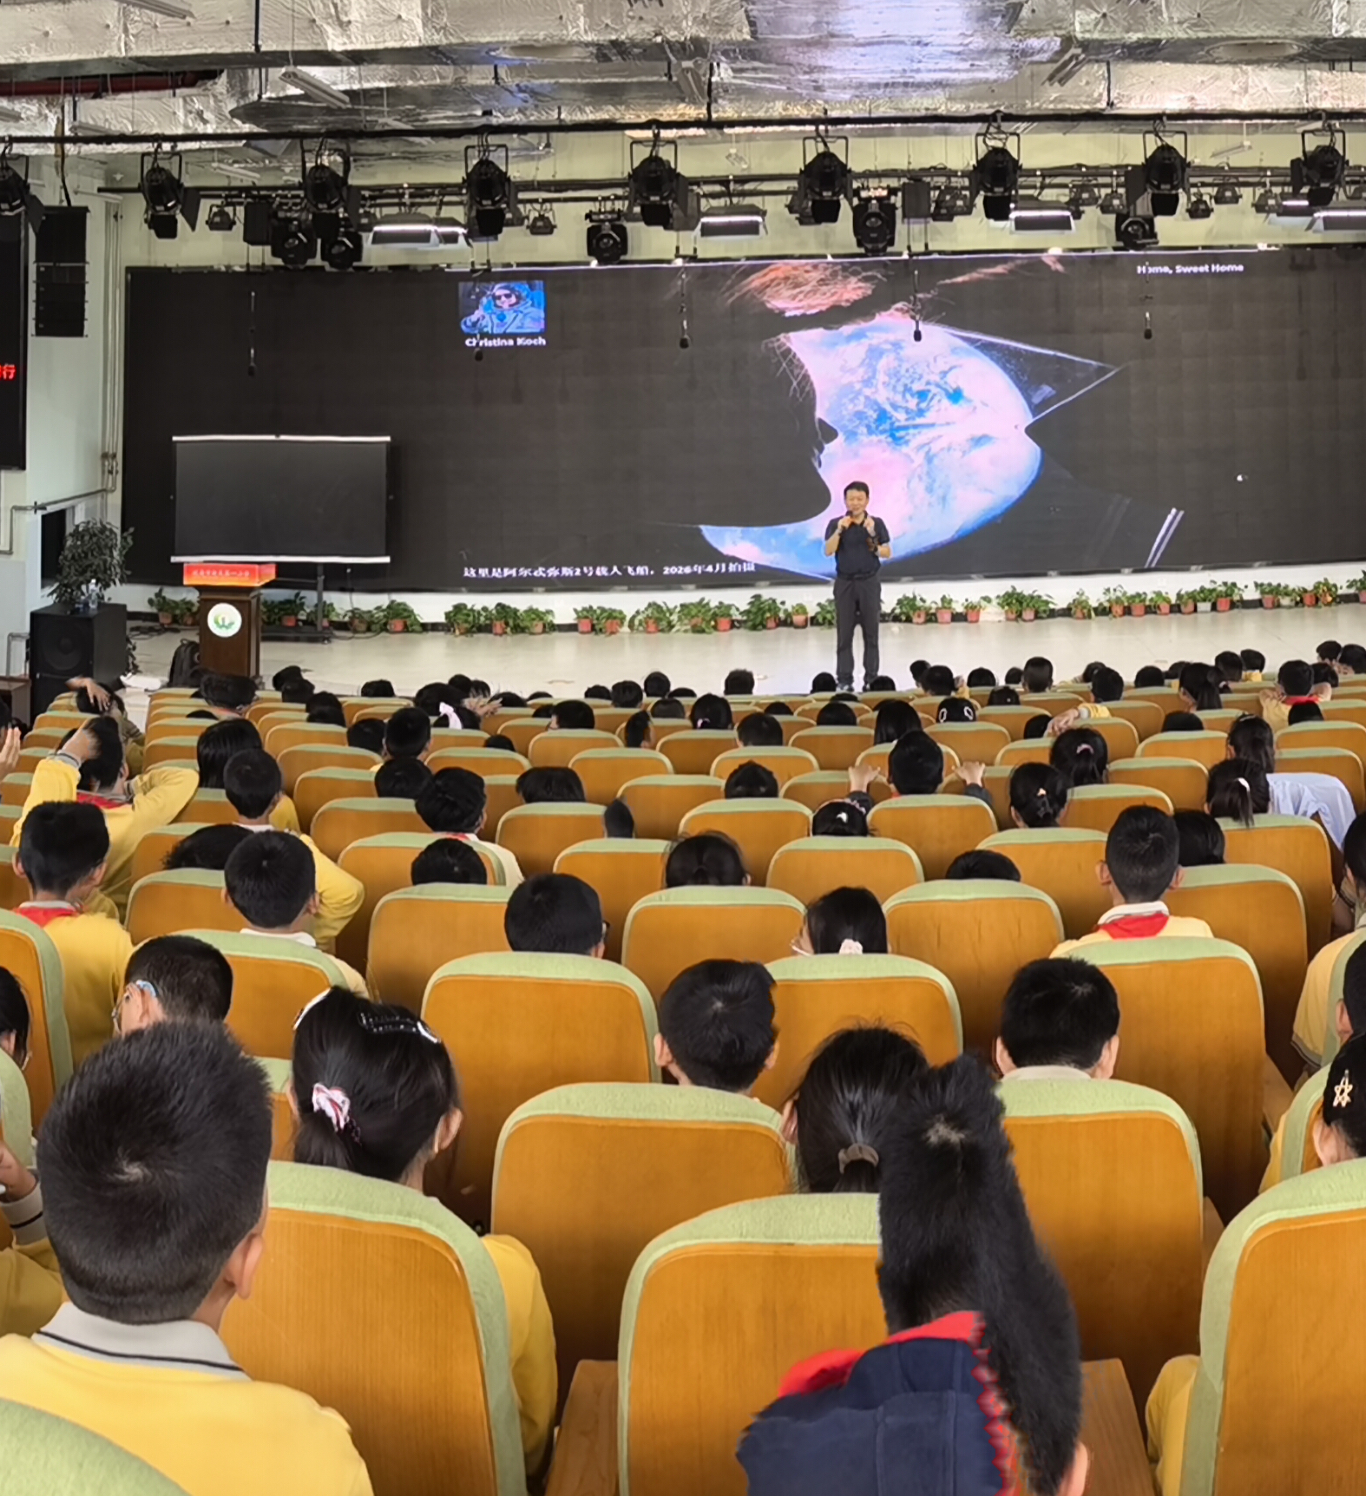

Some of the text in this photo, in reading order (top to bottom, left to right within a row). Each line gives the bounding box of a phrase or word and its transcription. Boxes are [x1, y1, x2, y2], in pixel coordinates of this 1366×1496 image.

[1175, 263, 1209, 274] Sweet
[1211, 262, 1244, 273] Home
[516, 336, 546, 347] Koch
